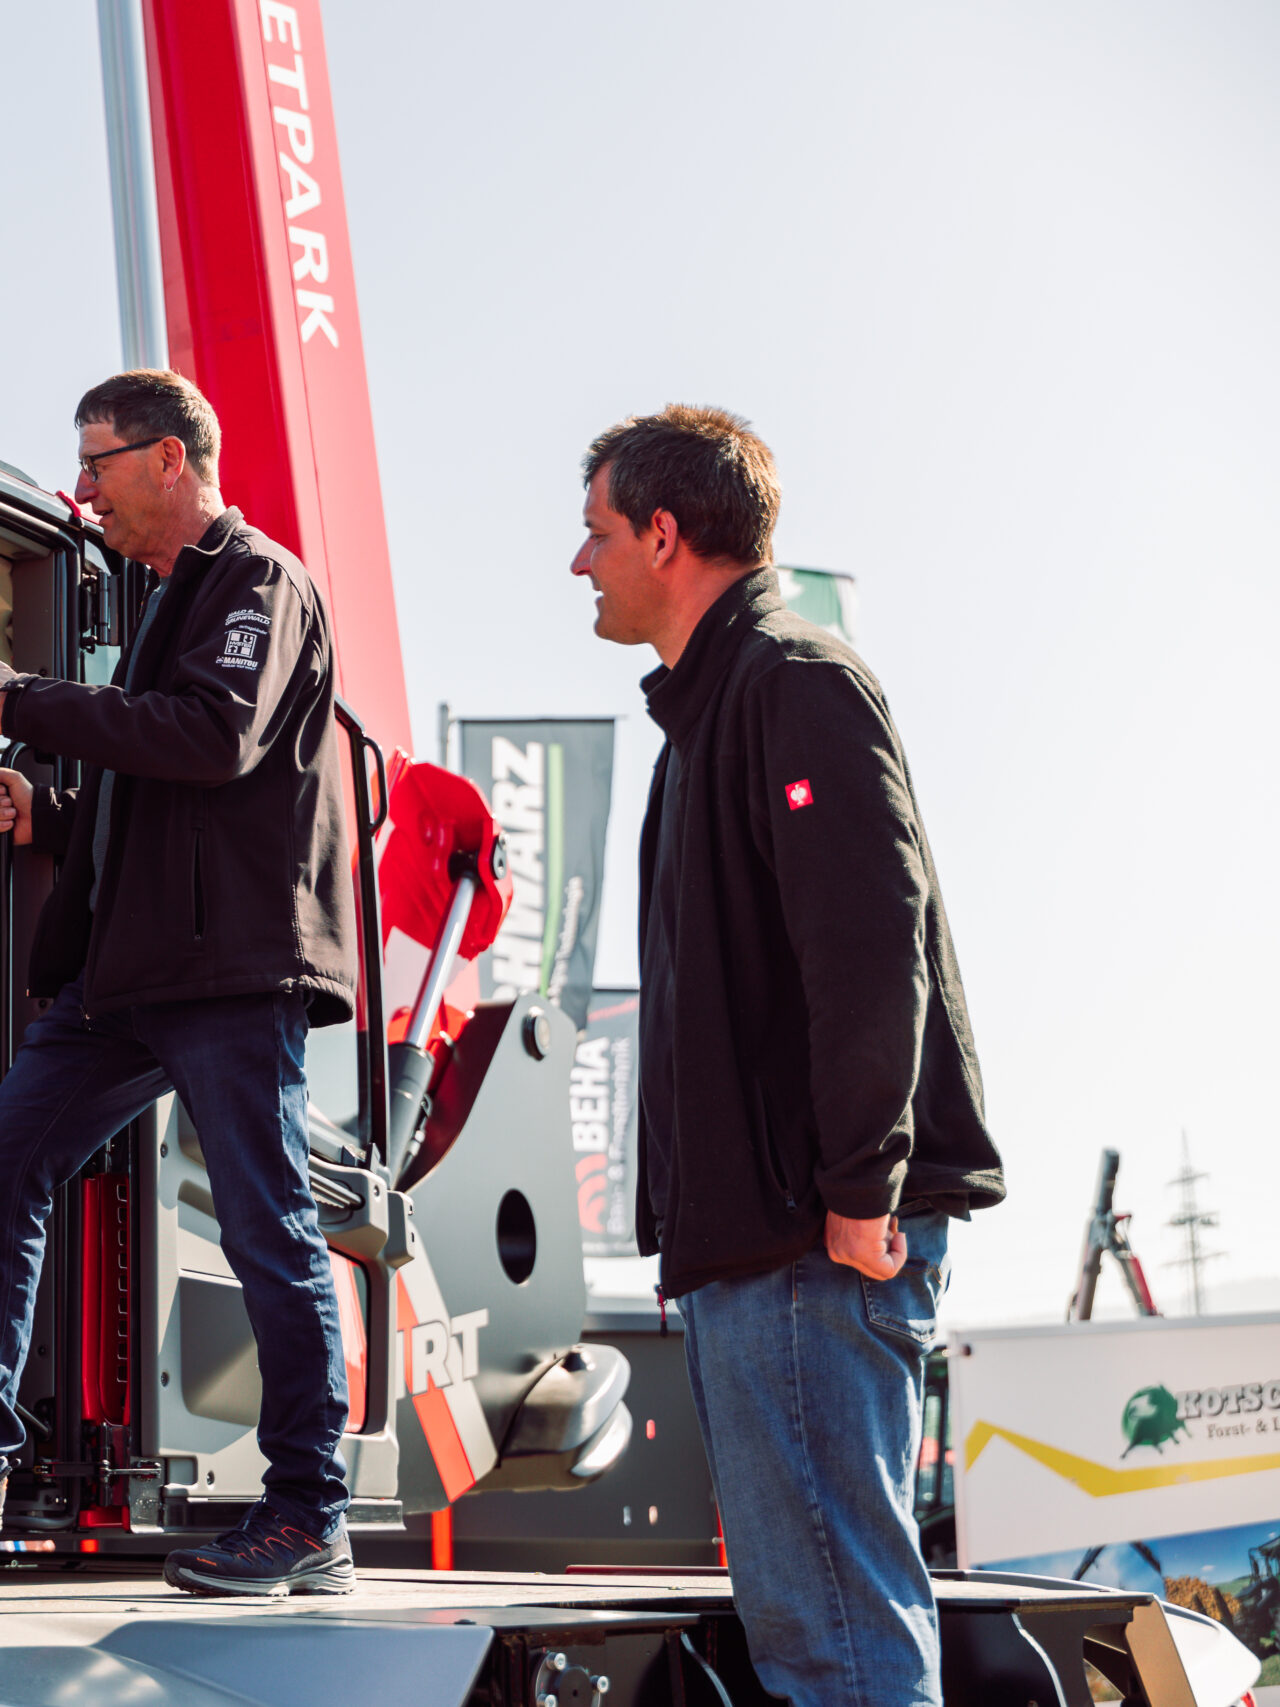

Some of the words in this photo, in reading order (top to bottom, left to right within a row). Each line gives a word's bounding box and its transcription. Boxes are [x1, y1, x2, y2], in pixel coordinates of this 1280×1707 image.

[260, 0, 339, 348] ETPARK
[223, 657, 258, 667] MANITOU
[569, 1036, 610, 1152] BEHA
